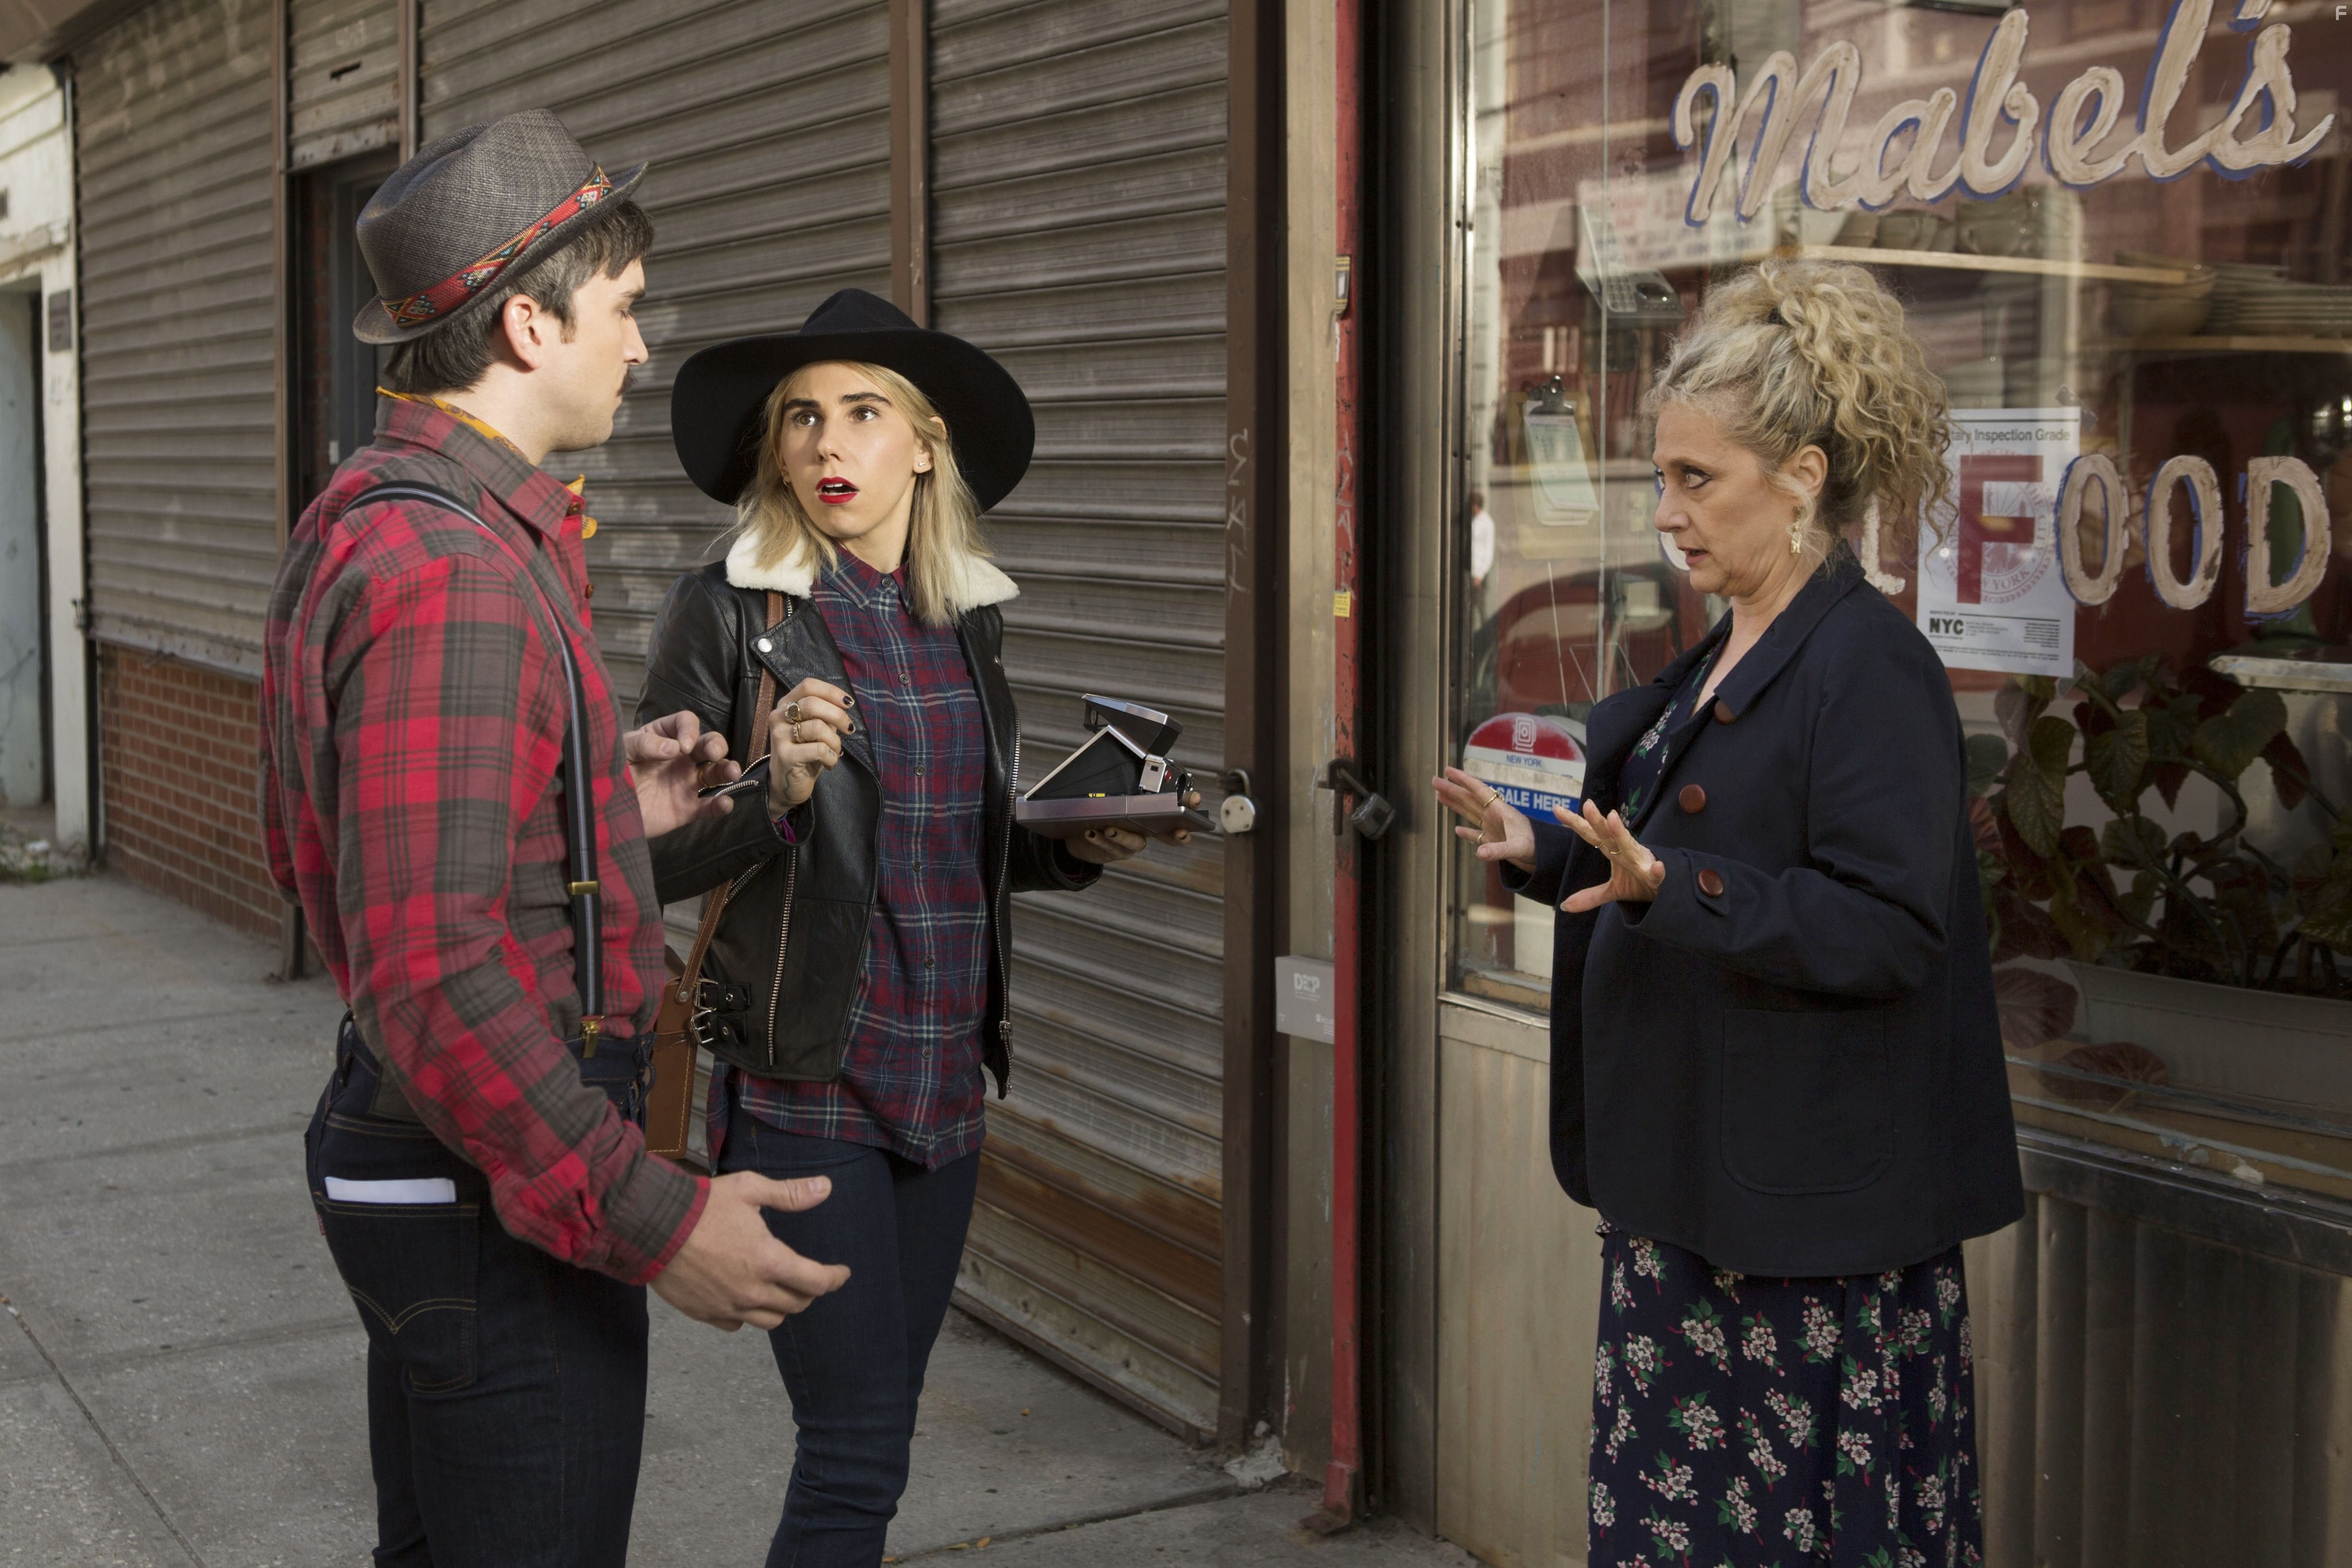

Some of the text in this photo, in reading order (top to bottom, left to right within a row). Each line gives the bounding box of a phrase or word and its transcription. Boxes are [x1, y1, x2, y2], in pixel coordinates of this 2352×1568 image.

[1670, 0, 2336, 227] Mabel's
[1974, 429, 2033, 444] Inspection
[2035, 429, 2071, 441] Grade
[2055, 454, 2331, 618] OOD
[1929, 618, 1964, 636] NYC
[1506, 754, 1542, 767] NEW YORK
